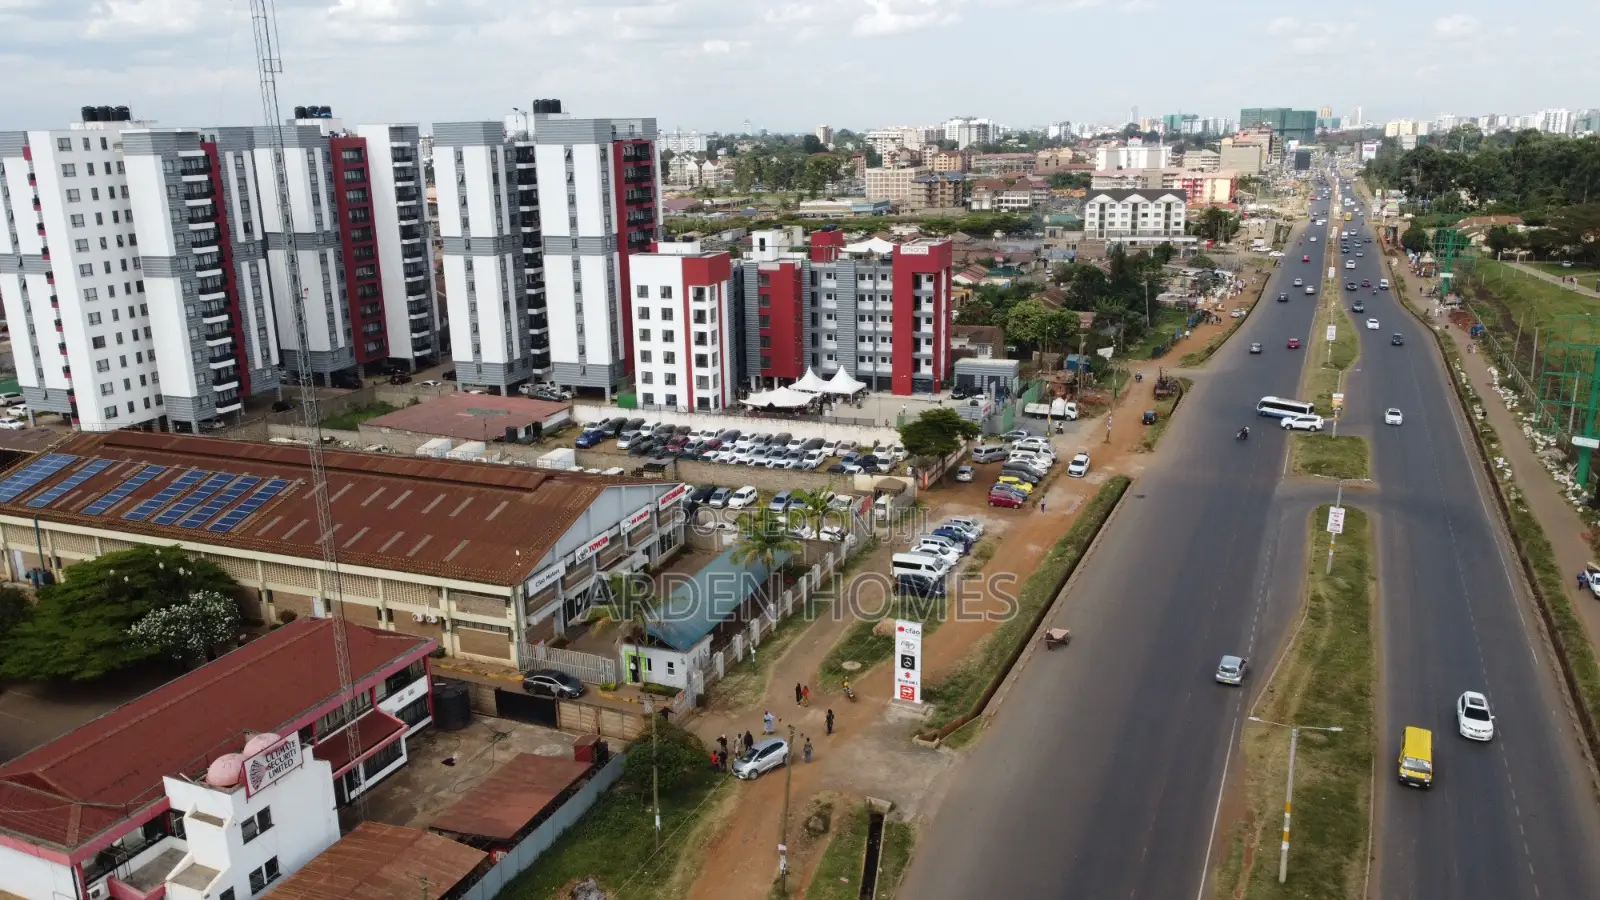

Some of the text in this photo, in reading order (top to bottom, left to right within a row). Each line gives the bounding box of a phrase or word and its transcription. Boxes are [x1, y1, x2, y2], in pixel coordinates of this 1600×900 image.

[588, 535, 609, 553] TOYOTA
[265, 739, 297, 763] ULTIMATE
[266, 749, 297, 770] SECURITY
[268, 758, 294, 779] LIMITED
